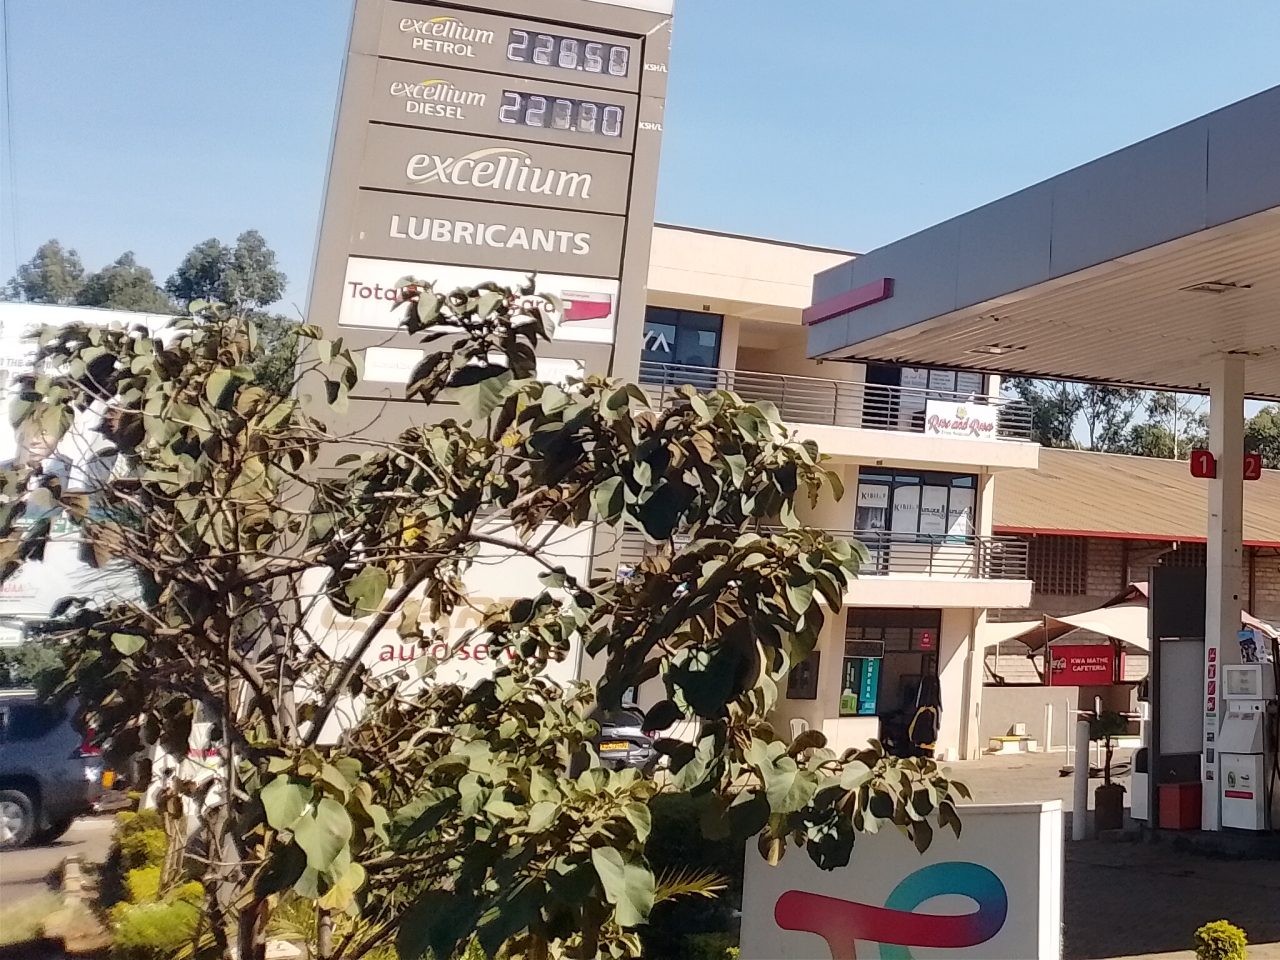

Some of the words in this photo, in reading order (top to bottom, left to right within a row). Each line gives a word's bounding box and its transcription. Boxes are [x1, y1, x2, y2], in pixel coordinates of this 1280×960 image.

[399, 17, 495, 44] excellium
[412, 38, 476, 58] PETROL
[390, 81, 486, 107] excellium
[406, 101, 466, 120] DIESEL
[406, 149, 592, 199] excellium
[390, 214, 591, 256] LUBRICANTS
[1199, 455, 1207, 474] 1
[1245, 457, 1256, 477] 2
[378, 642, 448, 663] auo
